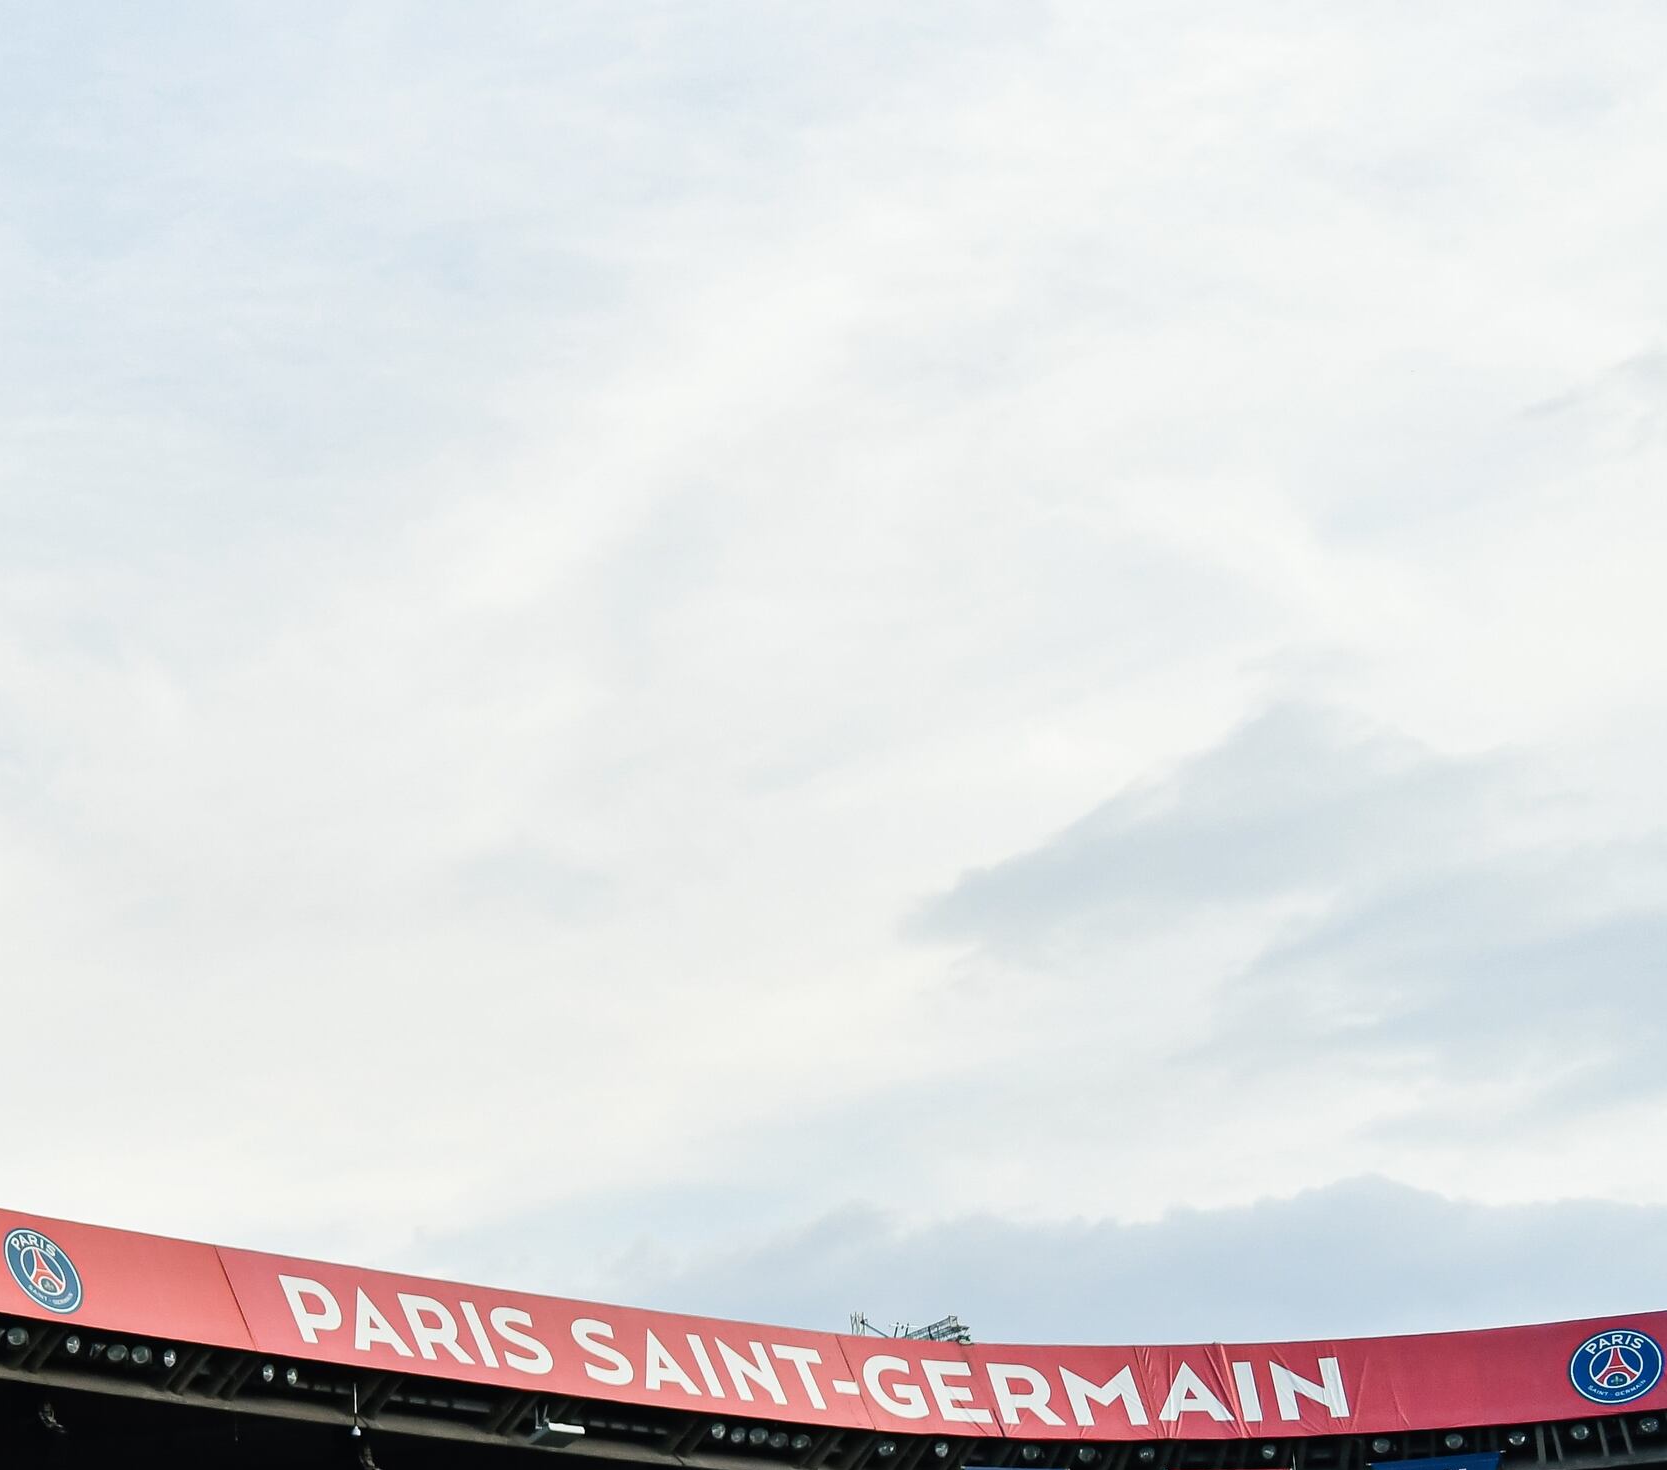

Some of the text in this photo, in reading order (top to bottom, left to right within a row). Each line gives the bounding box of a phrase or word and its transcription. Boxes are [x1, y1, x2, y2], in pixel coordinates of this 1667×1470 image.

[11, 1234, 56, 1257] PARIS
[278, 1274, 1351, 1427] PARIS SAINT-GERMAIN
[1585, 1334, 1644, 1354] PARIS
